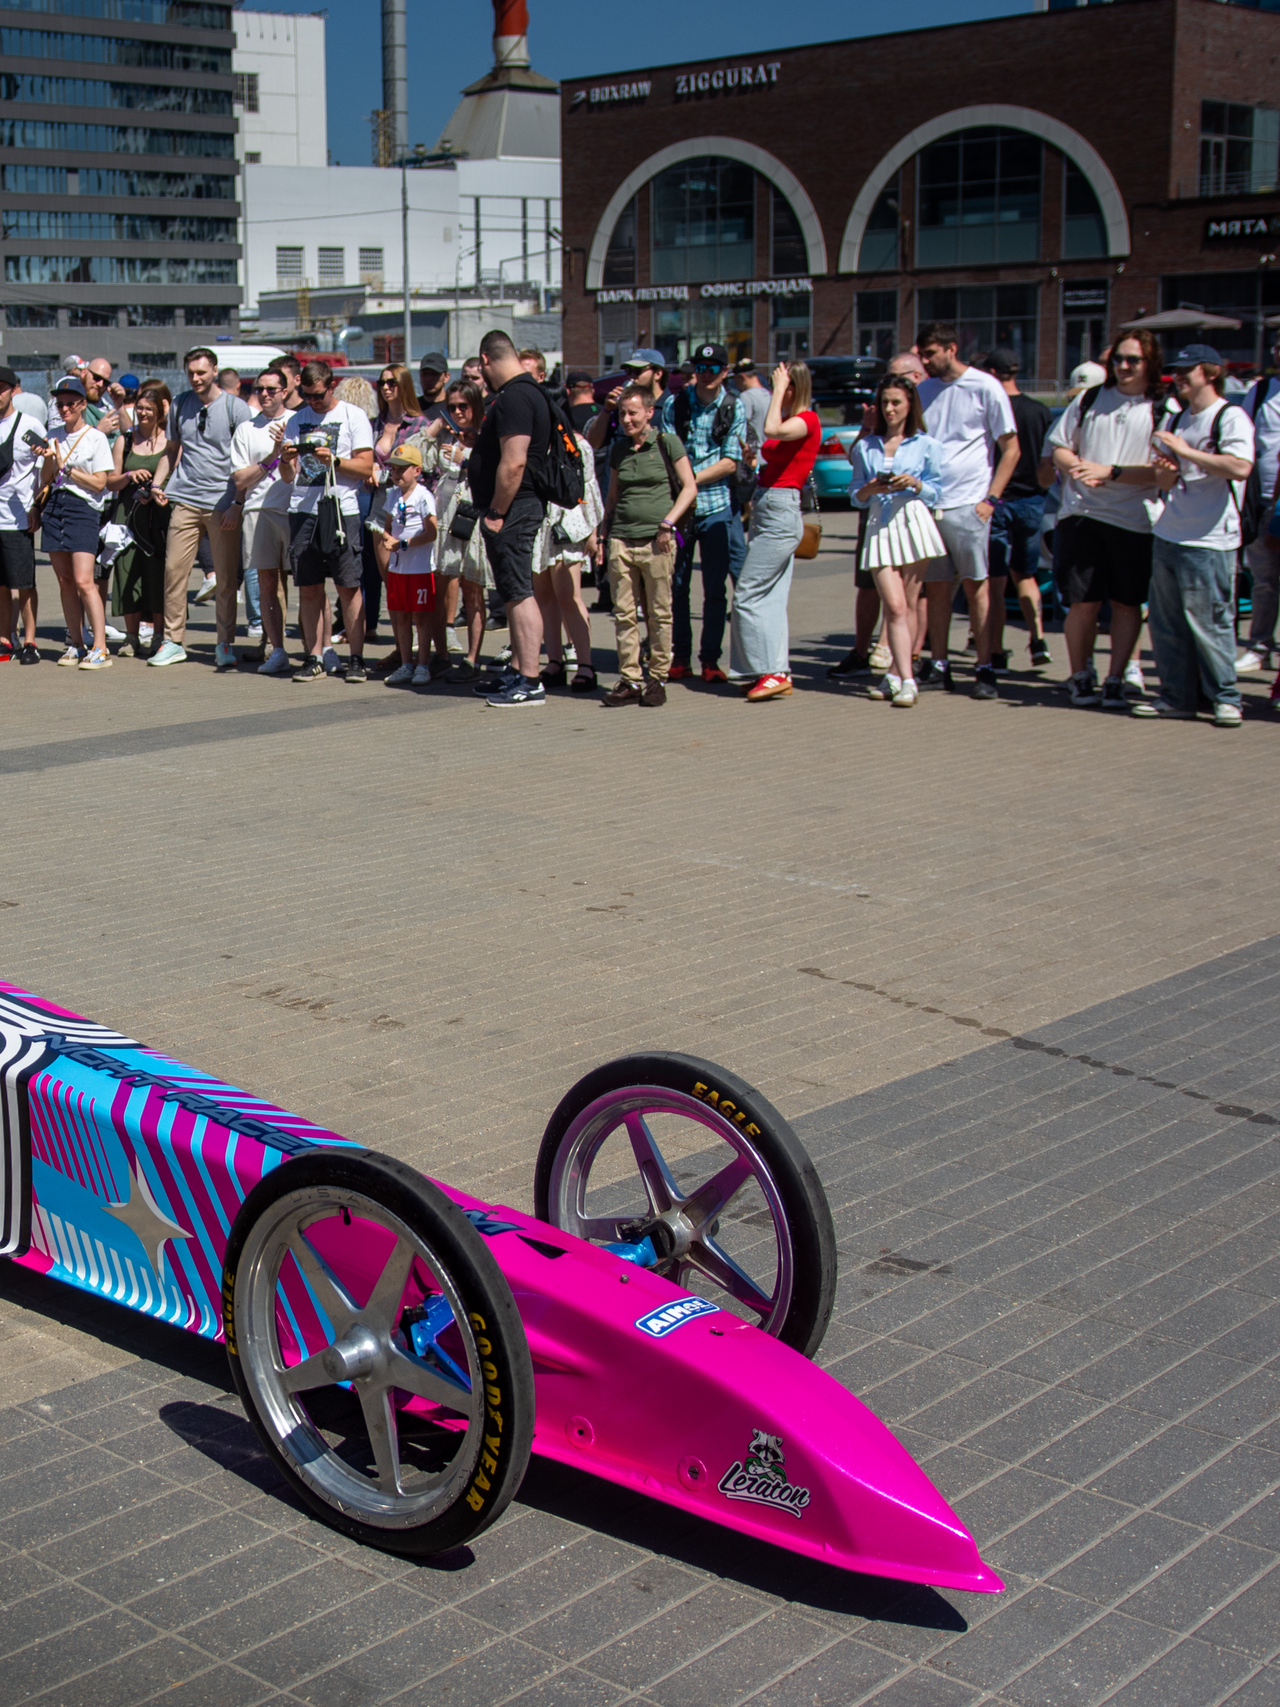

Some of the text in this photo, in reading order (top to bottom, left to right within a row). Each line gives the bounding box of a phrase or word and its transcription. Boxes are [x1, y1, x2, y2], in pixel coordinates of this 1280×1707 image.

[590, 80, 652, 103] BOXRAW
[675, 62, 781, 94] ZIGGURAT
[1208, 218, 1269, 237] МЯТА
[596, 285, 689, 303] ПАРК ЛЕГЕНД
[700, 278, 814, 298] ОФИС ПРОДАЖ
[416, 588, 428, 605] 27
[31, 1033, 320, 1155] NIGHT RACE
[691, 1080, 762, 1139] EAGLE
[223, 1267, 240, 1356] EAGLE
[646, 1299, 714, 1334] AIMOL
[466, 1312, 504, 1512] GOODYEAR
